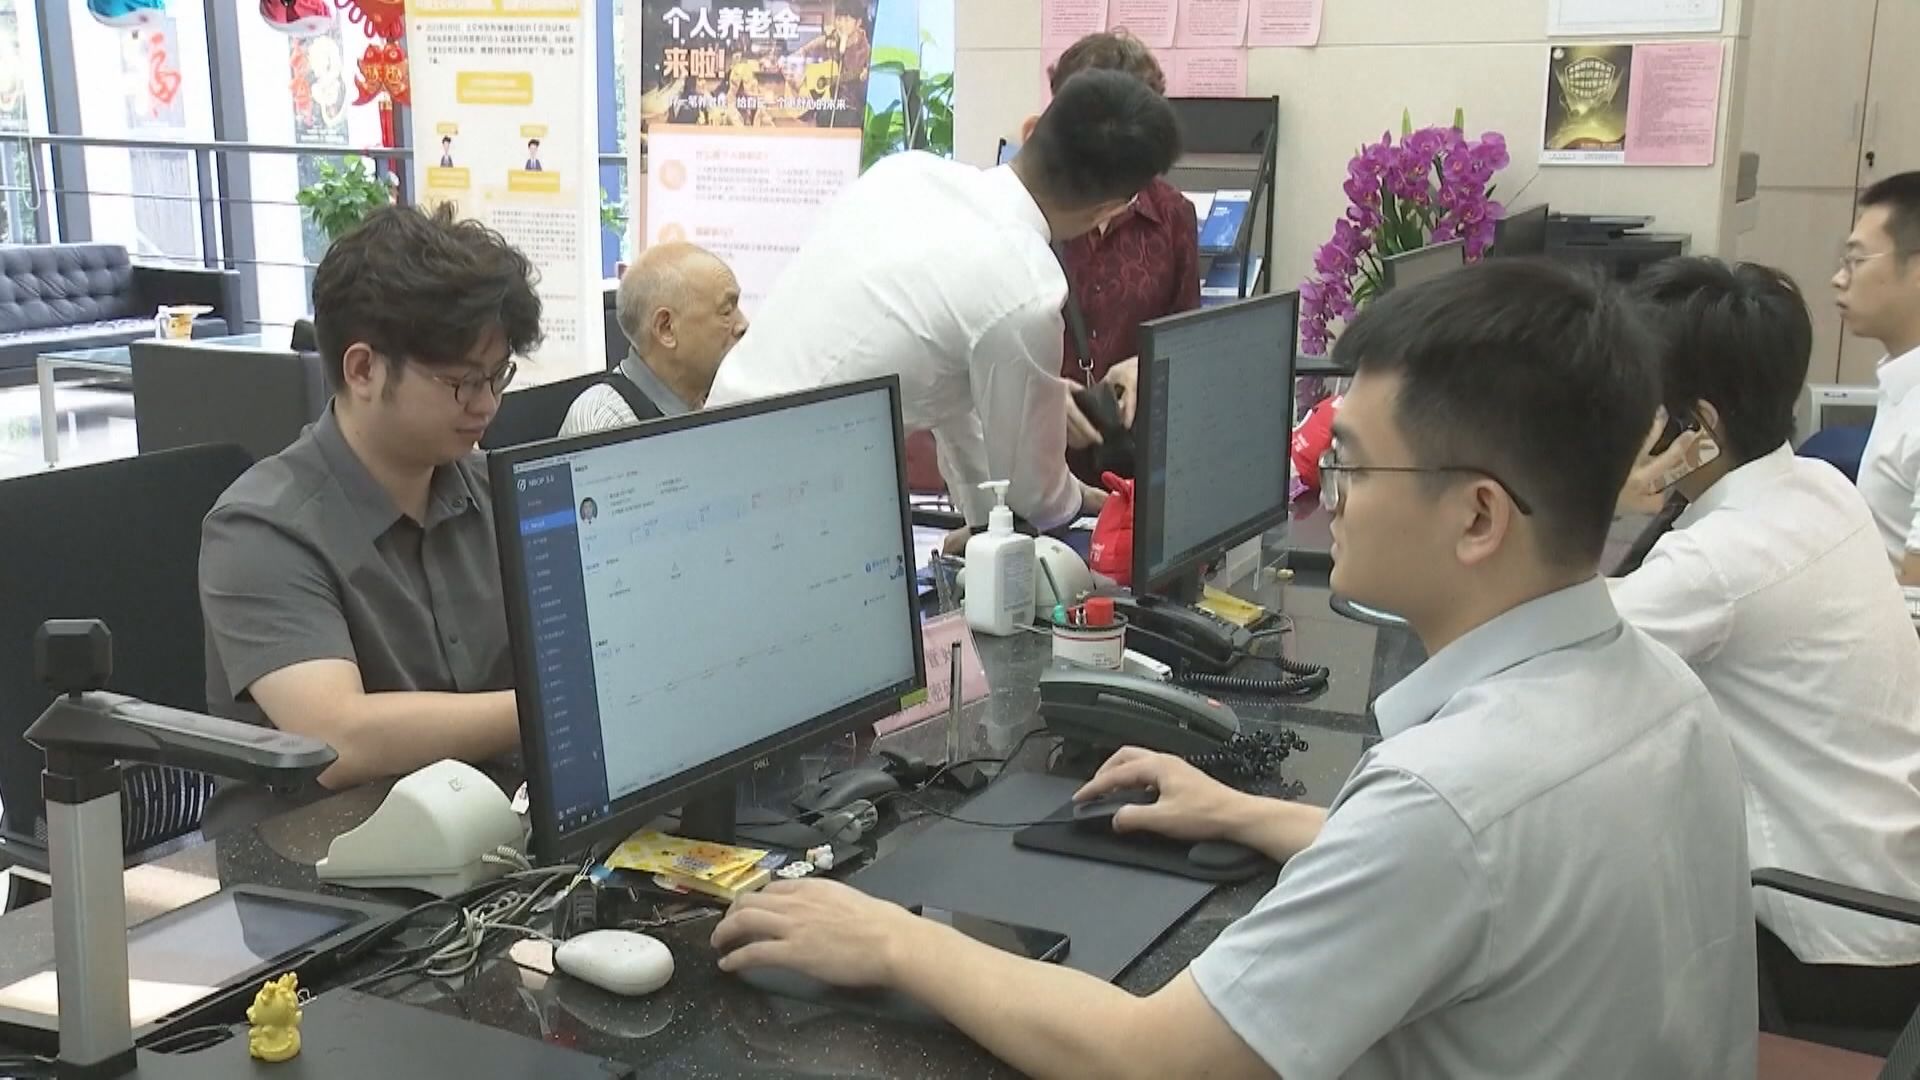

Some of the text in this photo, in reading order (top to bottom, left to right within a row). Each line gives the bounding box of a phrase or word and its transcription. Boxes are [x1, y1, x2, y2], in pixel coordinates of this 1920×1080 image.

[662, 7, 801, 40] 个人养老金
